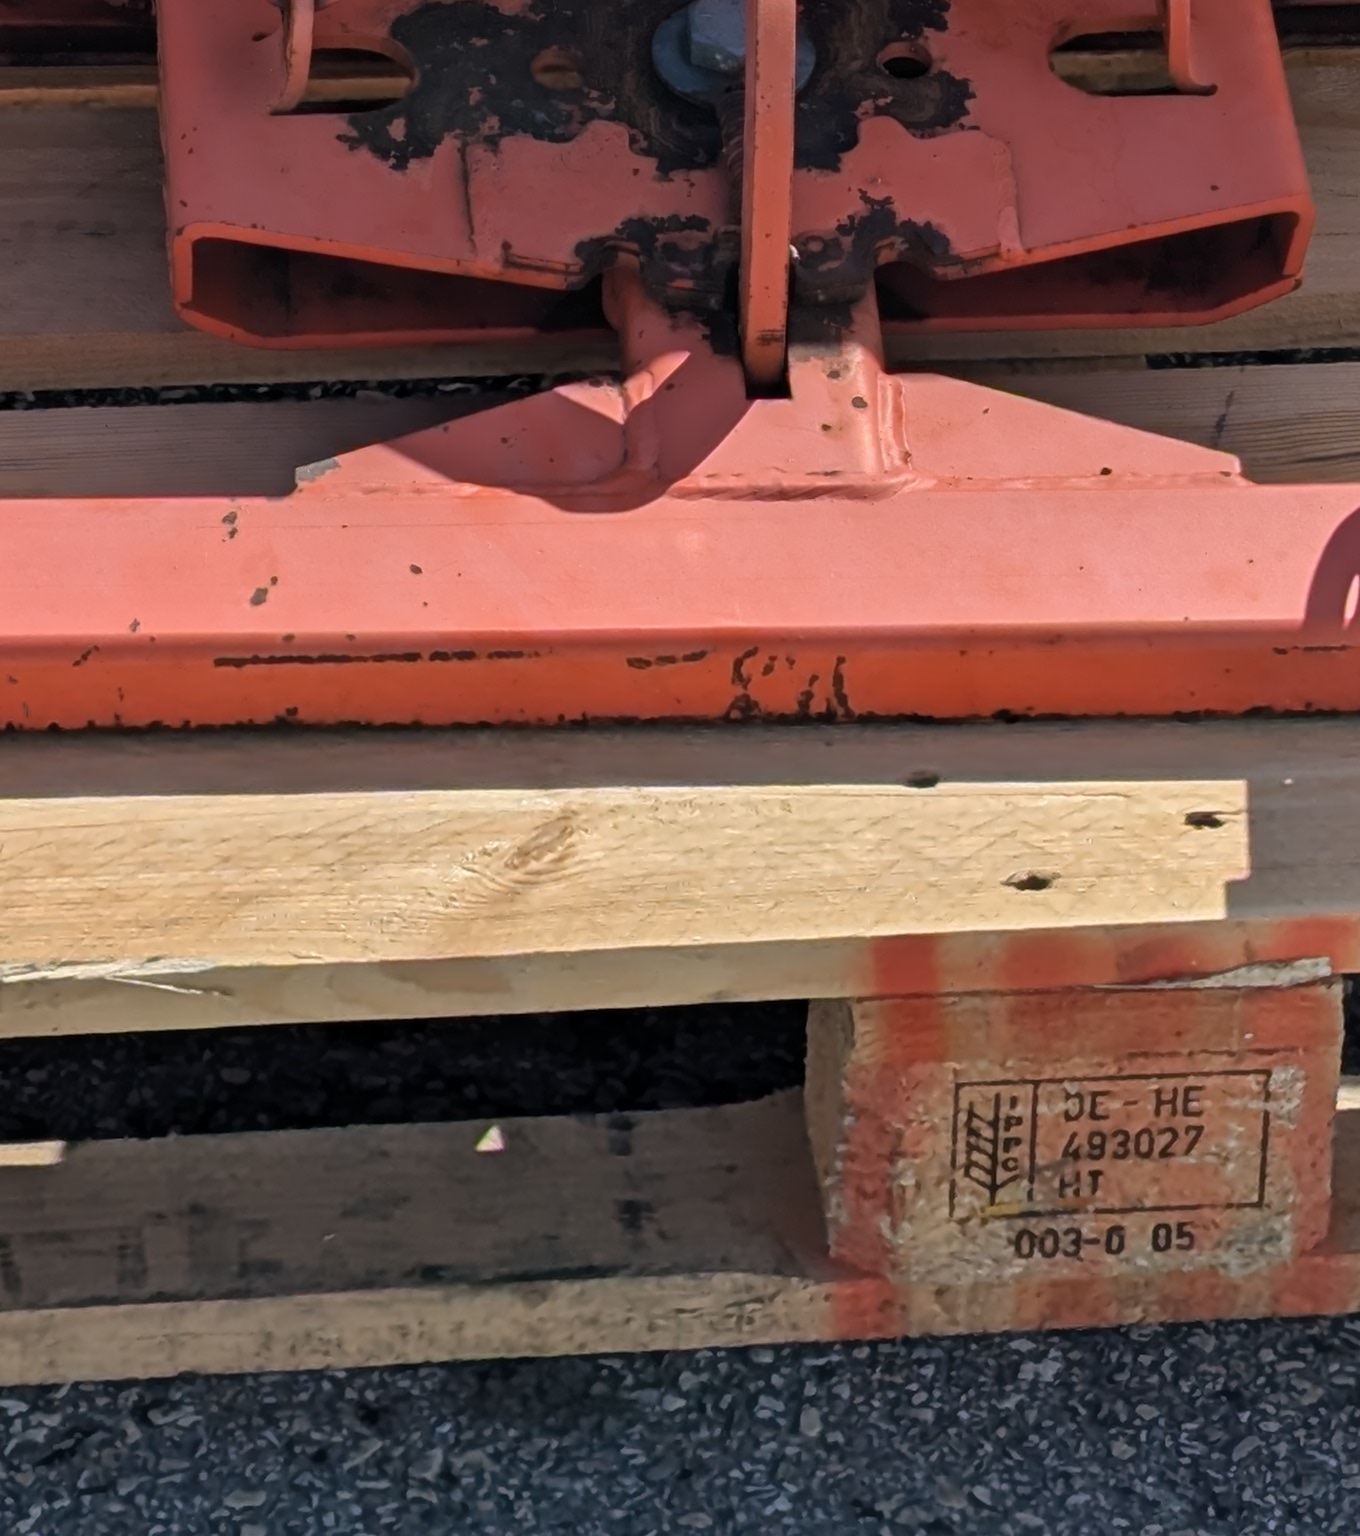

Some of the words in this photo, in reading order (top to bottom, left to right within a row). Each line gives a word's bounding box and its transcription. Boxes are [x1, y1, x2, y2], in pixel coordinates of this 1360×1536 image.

[1154, 1085, 1206, 1117] HE
[1062, 1125, 1205, 1160] 493027
[1059, 1170, 1104, 1198] HT
